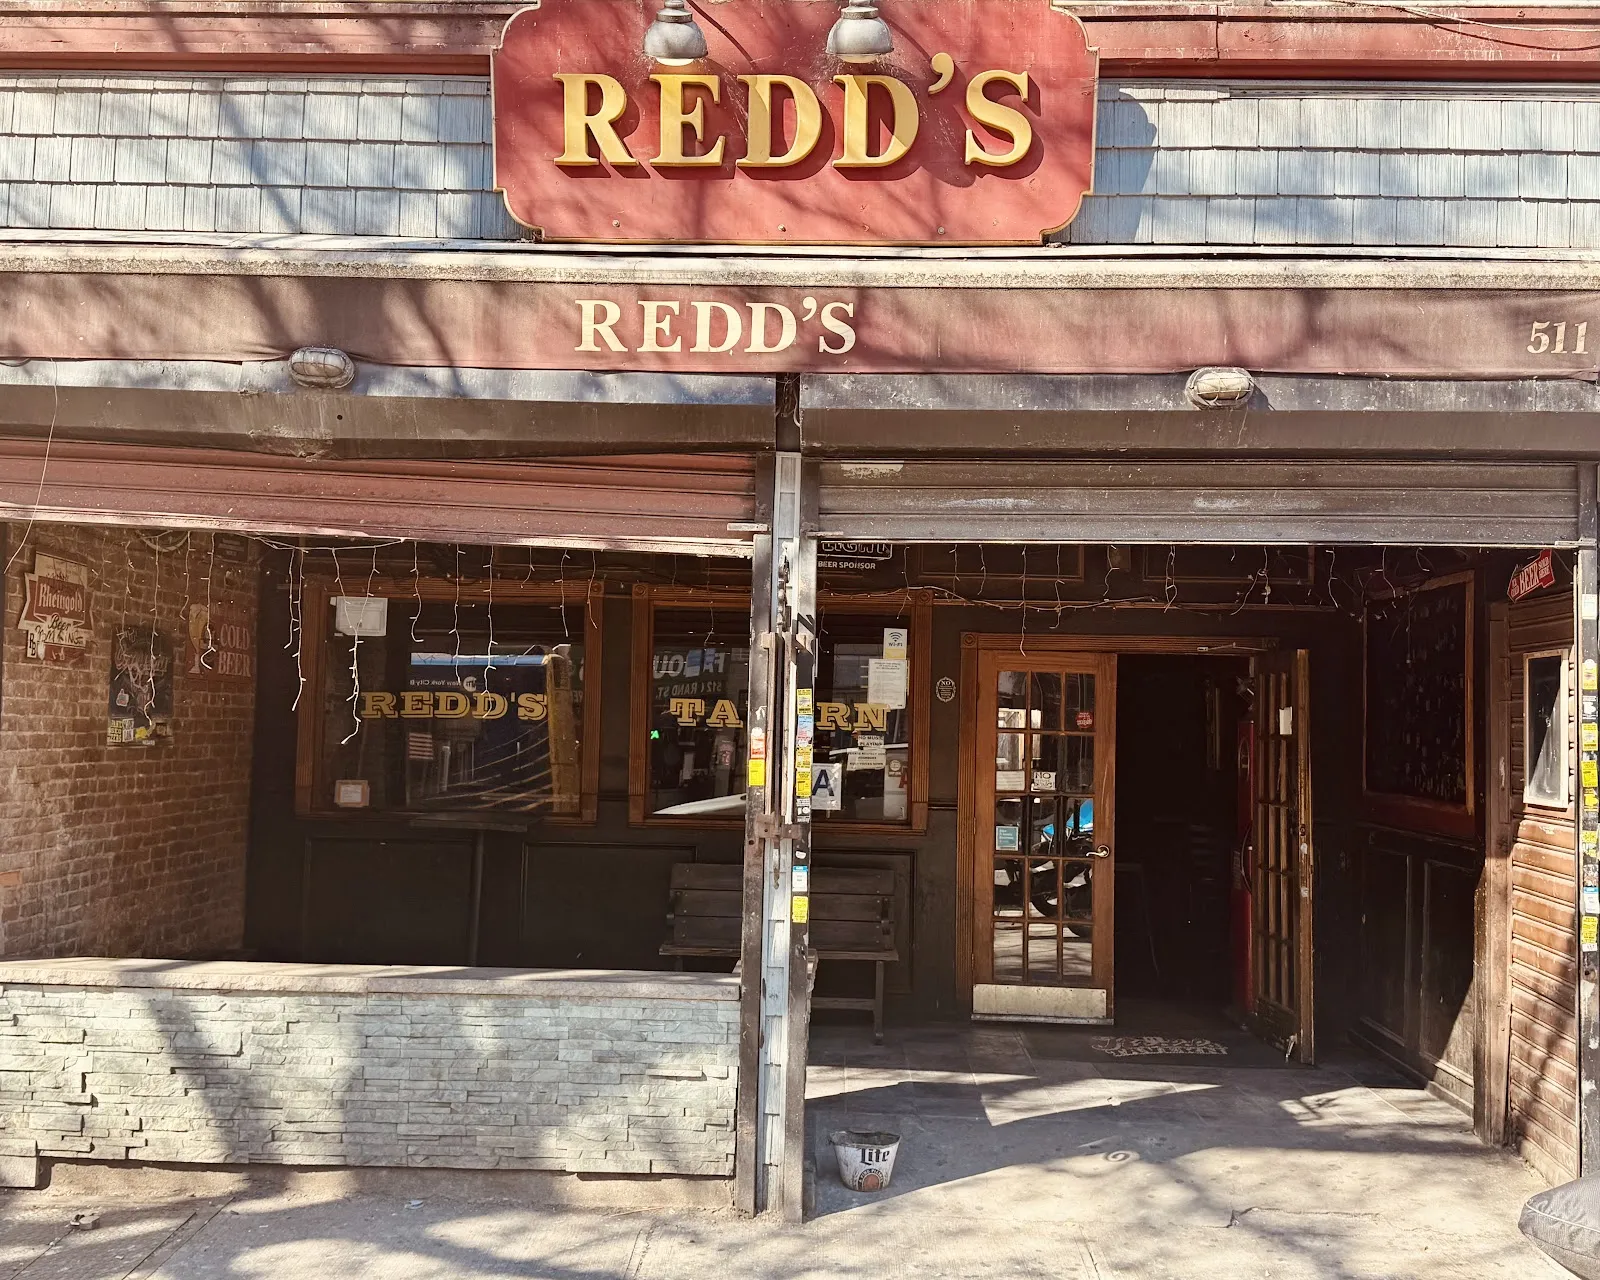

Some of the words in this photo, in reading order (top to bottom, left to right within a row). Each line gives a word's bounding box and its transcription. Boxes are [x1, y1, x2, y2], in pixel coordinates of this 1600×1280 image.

[553, 52, 1034, 168] REDD'S
[574, 296, 857, 355] REDD'S
[1526, 320, 1589, 355] 511
[817, 560, 838, 568] BEER
[838, 561, 876, 570] SPONSOR
[1519, 562, 1540, 594] BEER
[38, 582, 84, 614] Rheingold
[47, 612, 72, 632] Beer
[220, 623, 250, 651] COLD
[217, 650, 252, 678] BEER
[360, 691, 548, 721] REDD'S
[812, 769, 835, 797] A
[1034, 771, 1053, 780] NO
[860, 1148, 890, 1166] Lite
